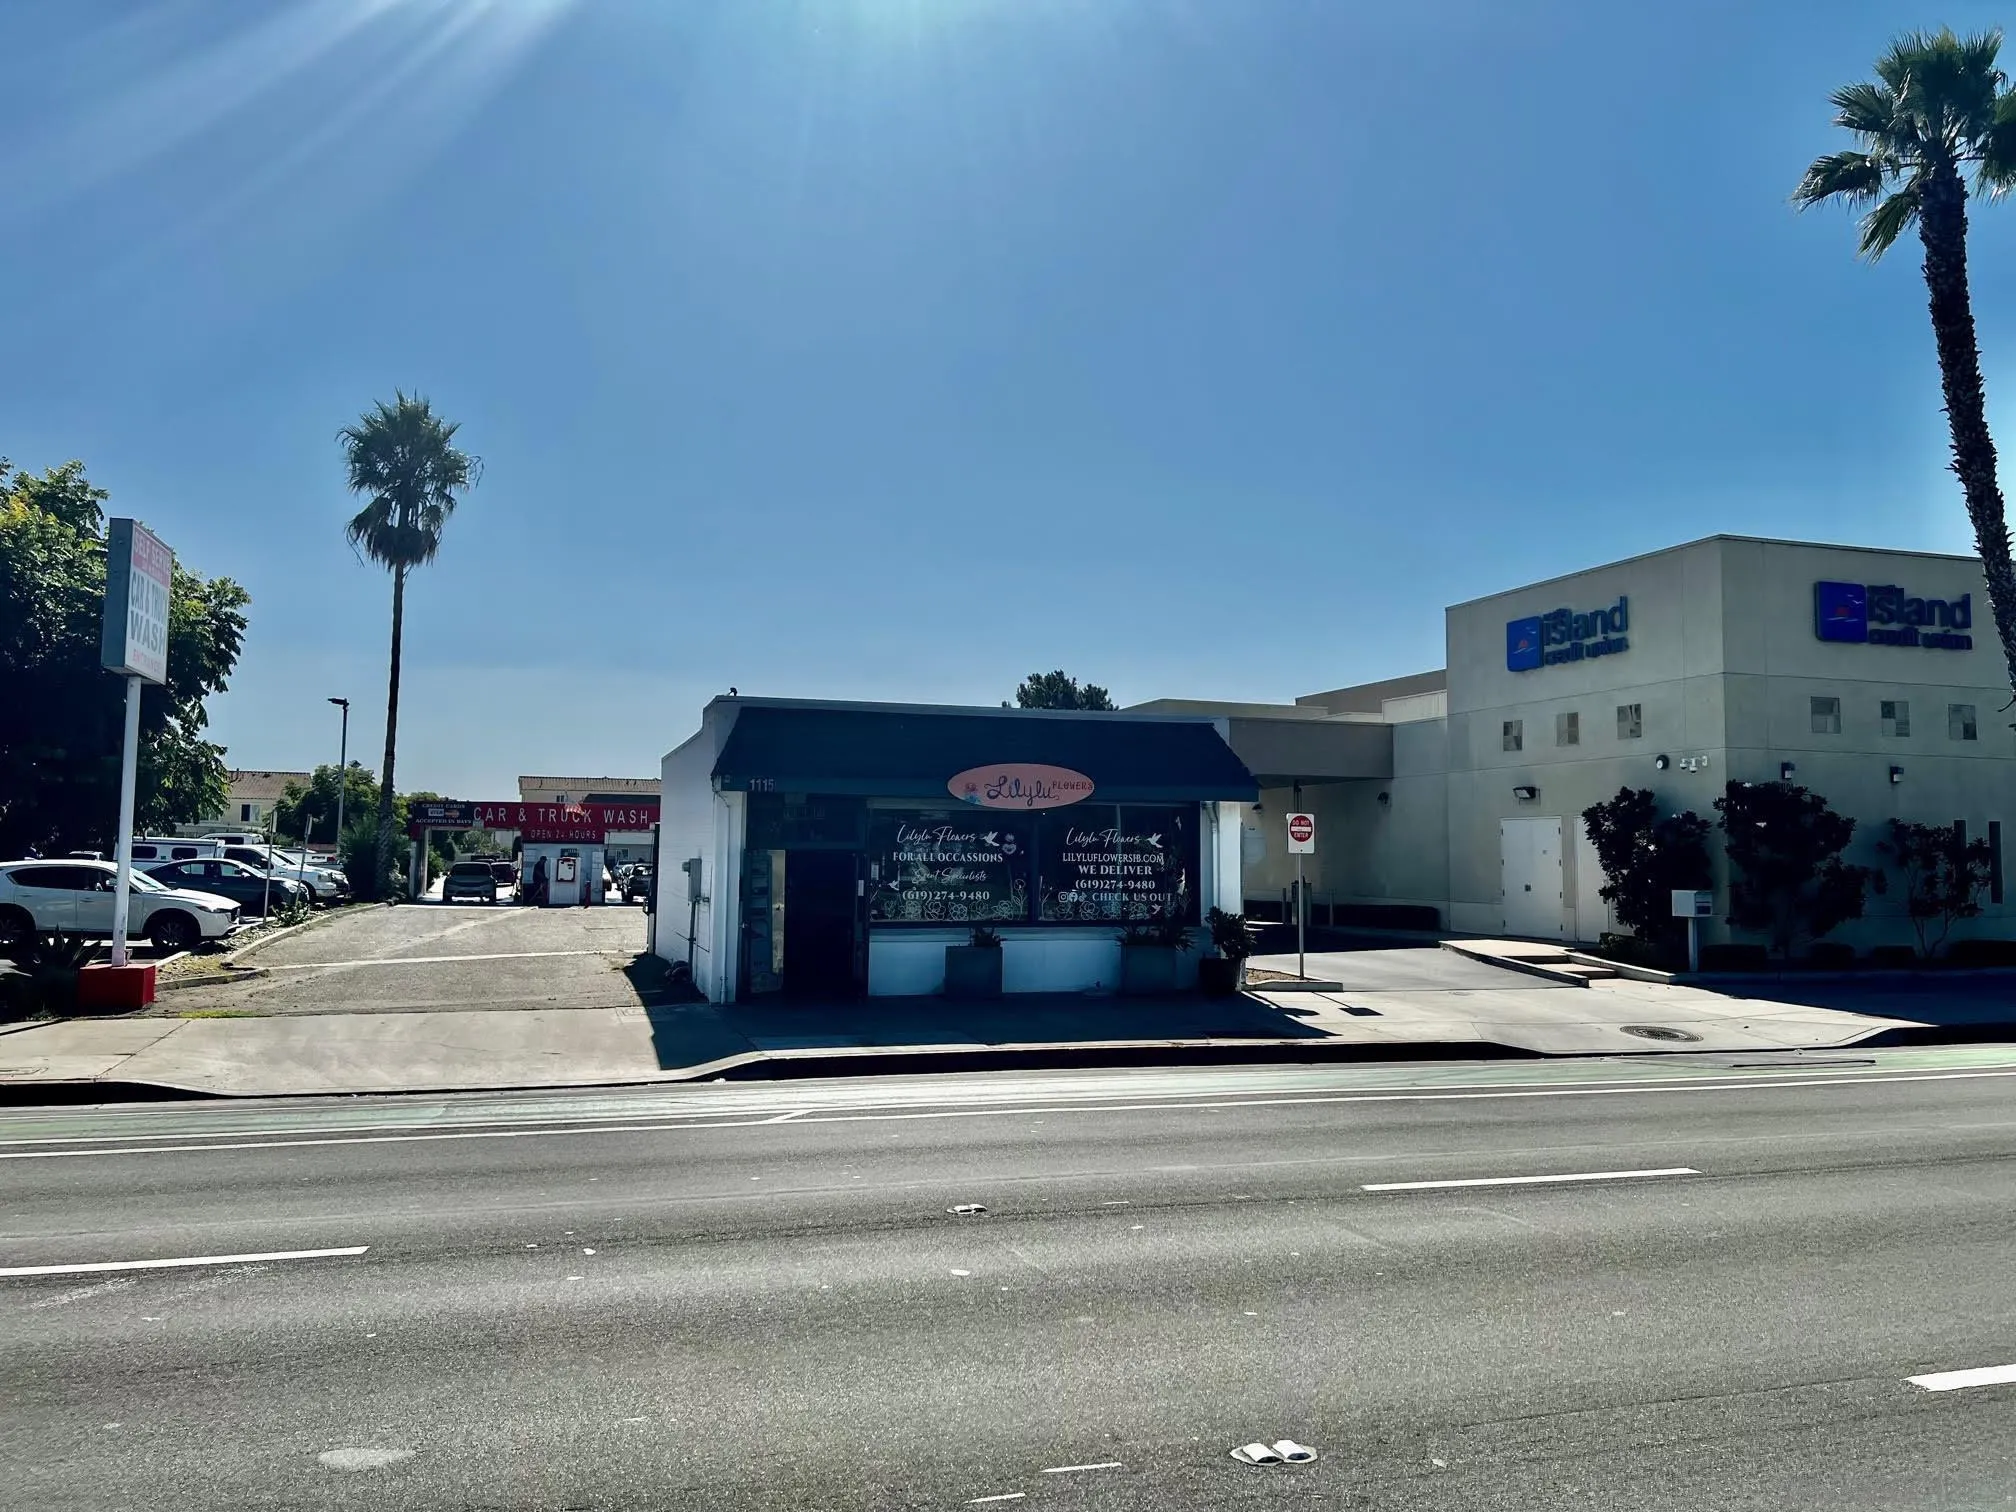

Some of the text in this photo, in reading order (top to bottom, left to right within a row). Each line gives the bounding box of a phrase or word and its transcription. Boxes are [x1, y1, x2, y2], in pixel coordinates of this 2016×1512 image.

[134, 531, 149, 562] SELF
[131, 570, 144, 613] CAR
[1867, 584, 1972, 629] island
[1543, 595, 1629, 646] island
[130, 610, 165, 657] WASH
[749, 778, 774, 793] 1115
[984, 775, 1093, 807] Lilylu FLOWERS
[473, 806, 507, 823] CAR
[518, 807, 528, 822] &
[538, 807, 593, 823] TRUCK
[603, 808, 649, 824] WASH
[530, 829, 552, 840] OPEN
[568, 829, 597, 841] HOURS
[897, 824, 978, 847] Lilylu Flowers
[1066, 827, 1142, 848] Lilylu Flowers
[893, 851, 1004, 863] FOR ALL OCCASSIONS
[1062, 852, 1164, 863] LILYLUFLOWERSIB.COM
[1078, 864, 1153, 875] WE DELIVER
[1075, 879, 1156, 890] (619)274-9480
[902, 890, 990, 901] (619)274-9480
[1092, 892, 1173, 902] CHECK US OUT
